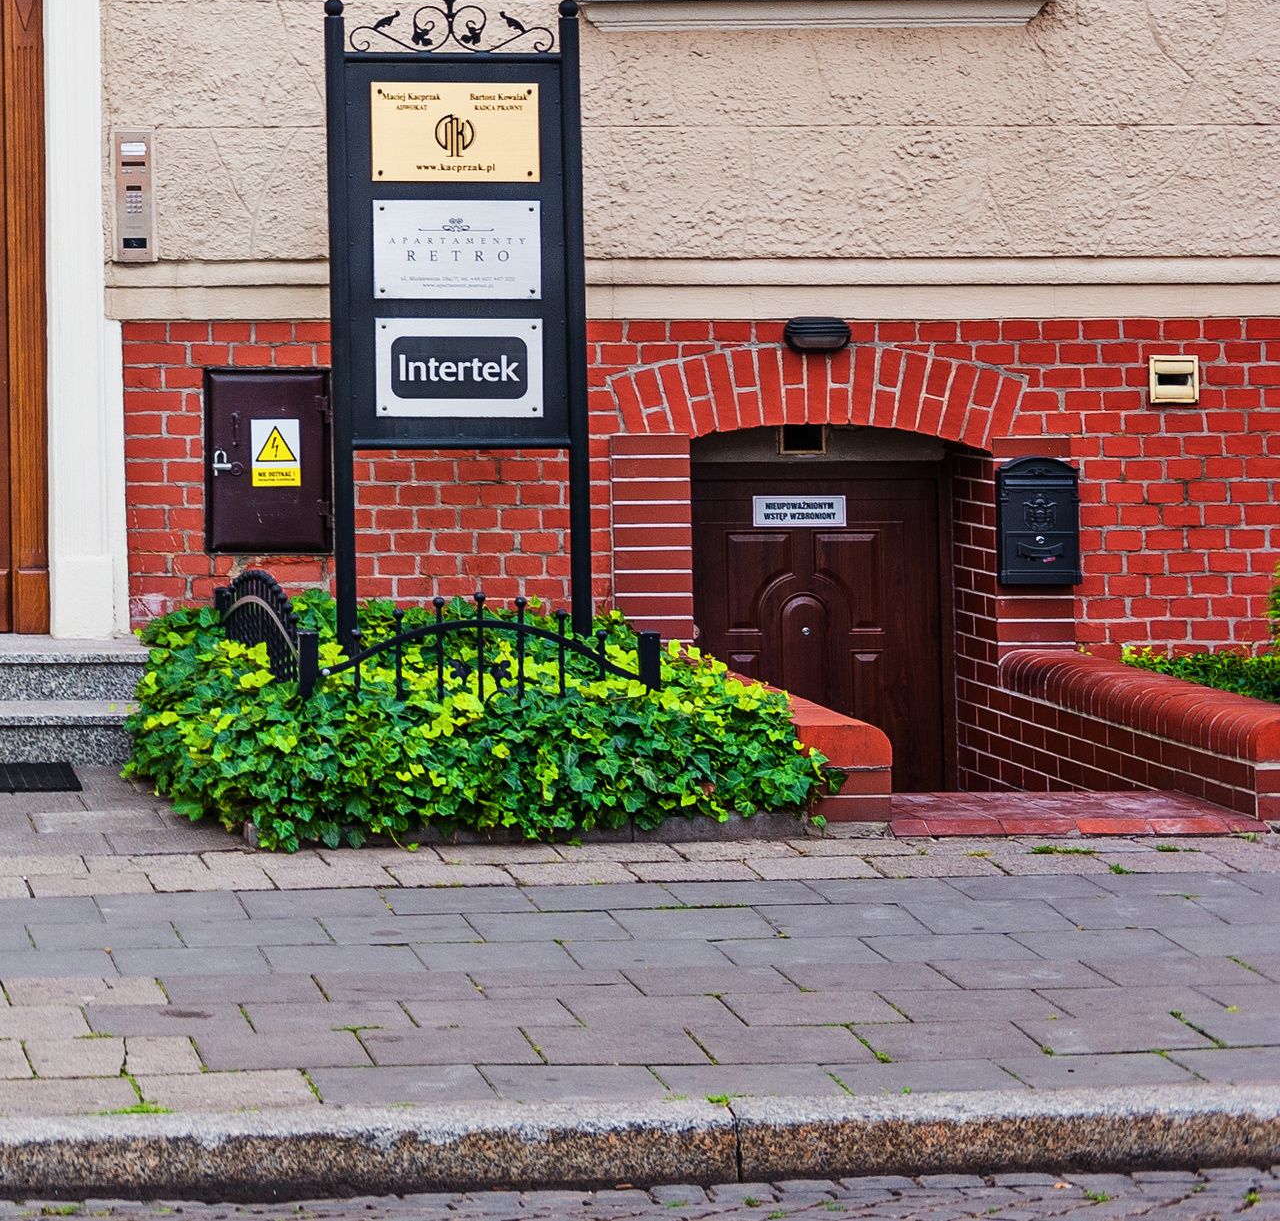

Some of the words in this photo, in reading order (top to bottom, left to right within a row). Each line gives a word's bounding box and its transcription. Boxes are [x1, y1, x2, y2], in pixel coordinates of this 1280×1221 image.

[382, 93, 406, 102] Maciej
[408, 93, 441, 102] Kacprzak
[469, 93, 495, 101] Bartosz
[416, 163, 496, 173] www.kacprzak.pl
[389, 237, 527, 245] APARTAMENTY
[407, 249, 510, 262] RETRO
[398, 353, 520, 382] Intertek
[765, 501, 834, 510] NIEUPOWAŻNIONYM
[763, 512, 788, 521] WSTĘP
[790, 512, 837, 520] WZBRONIONY
